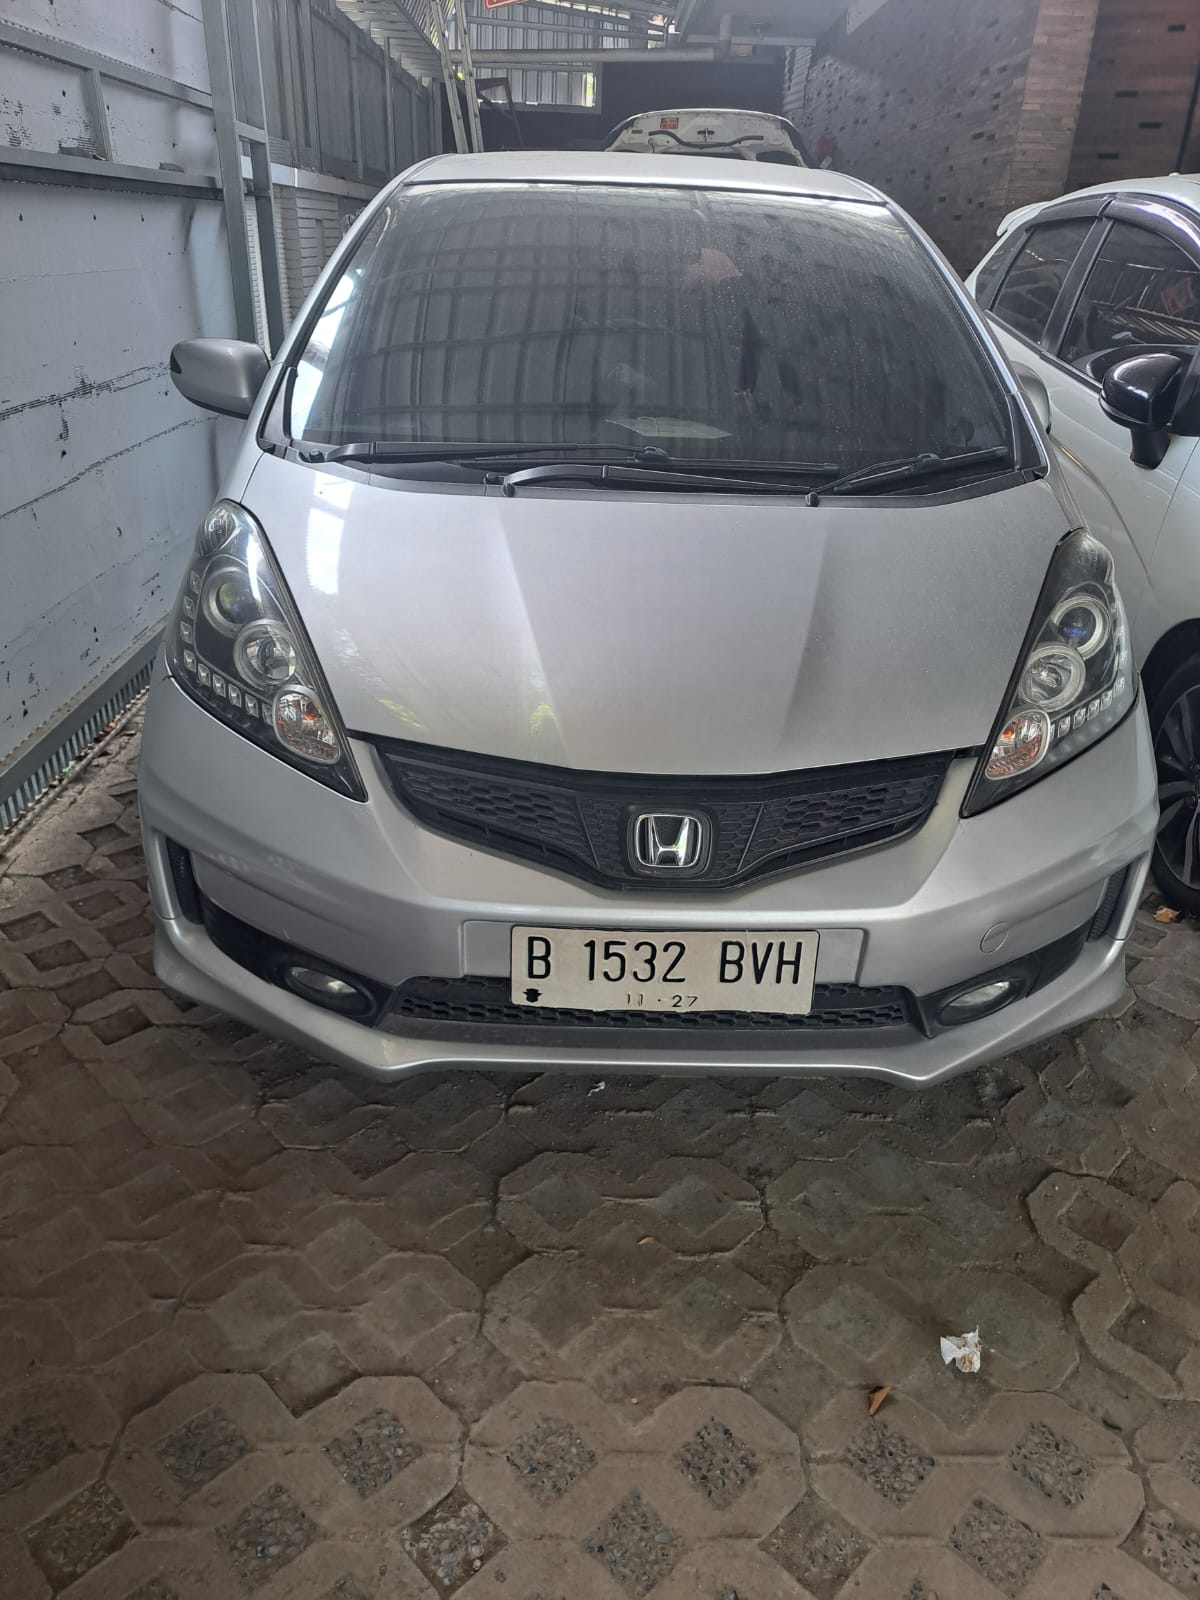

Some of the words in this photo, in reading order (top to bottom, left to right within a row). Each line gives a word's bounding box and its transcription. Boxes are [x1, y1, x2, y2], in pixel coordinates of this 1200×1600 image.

[527, 936, 551, 979] B
[584, 939, 686, 983] 1532
[719, 940, 802, 985] BVH
